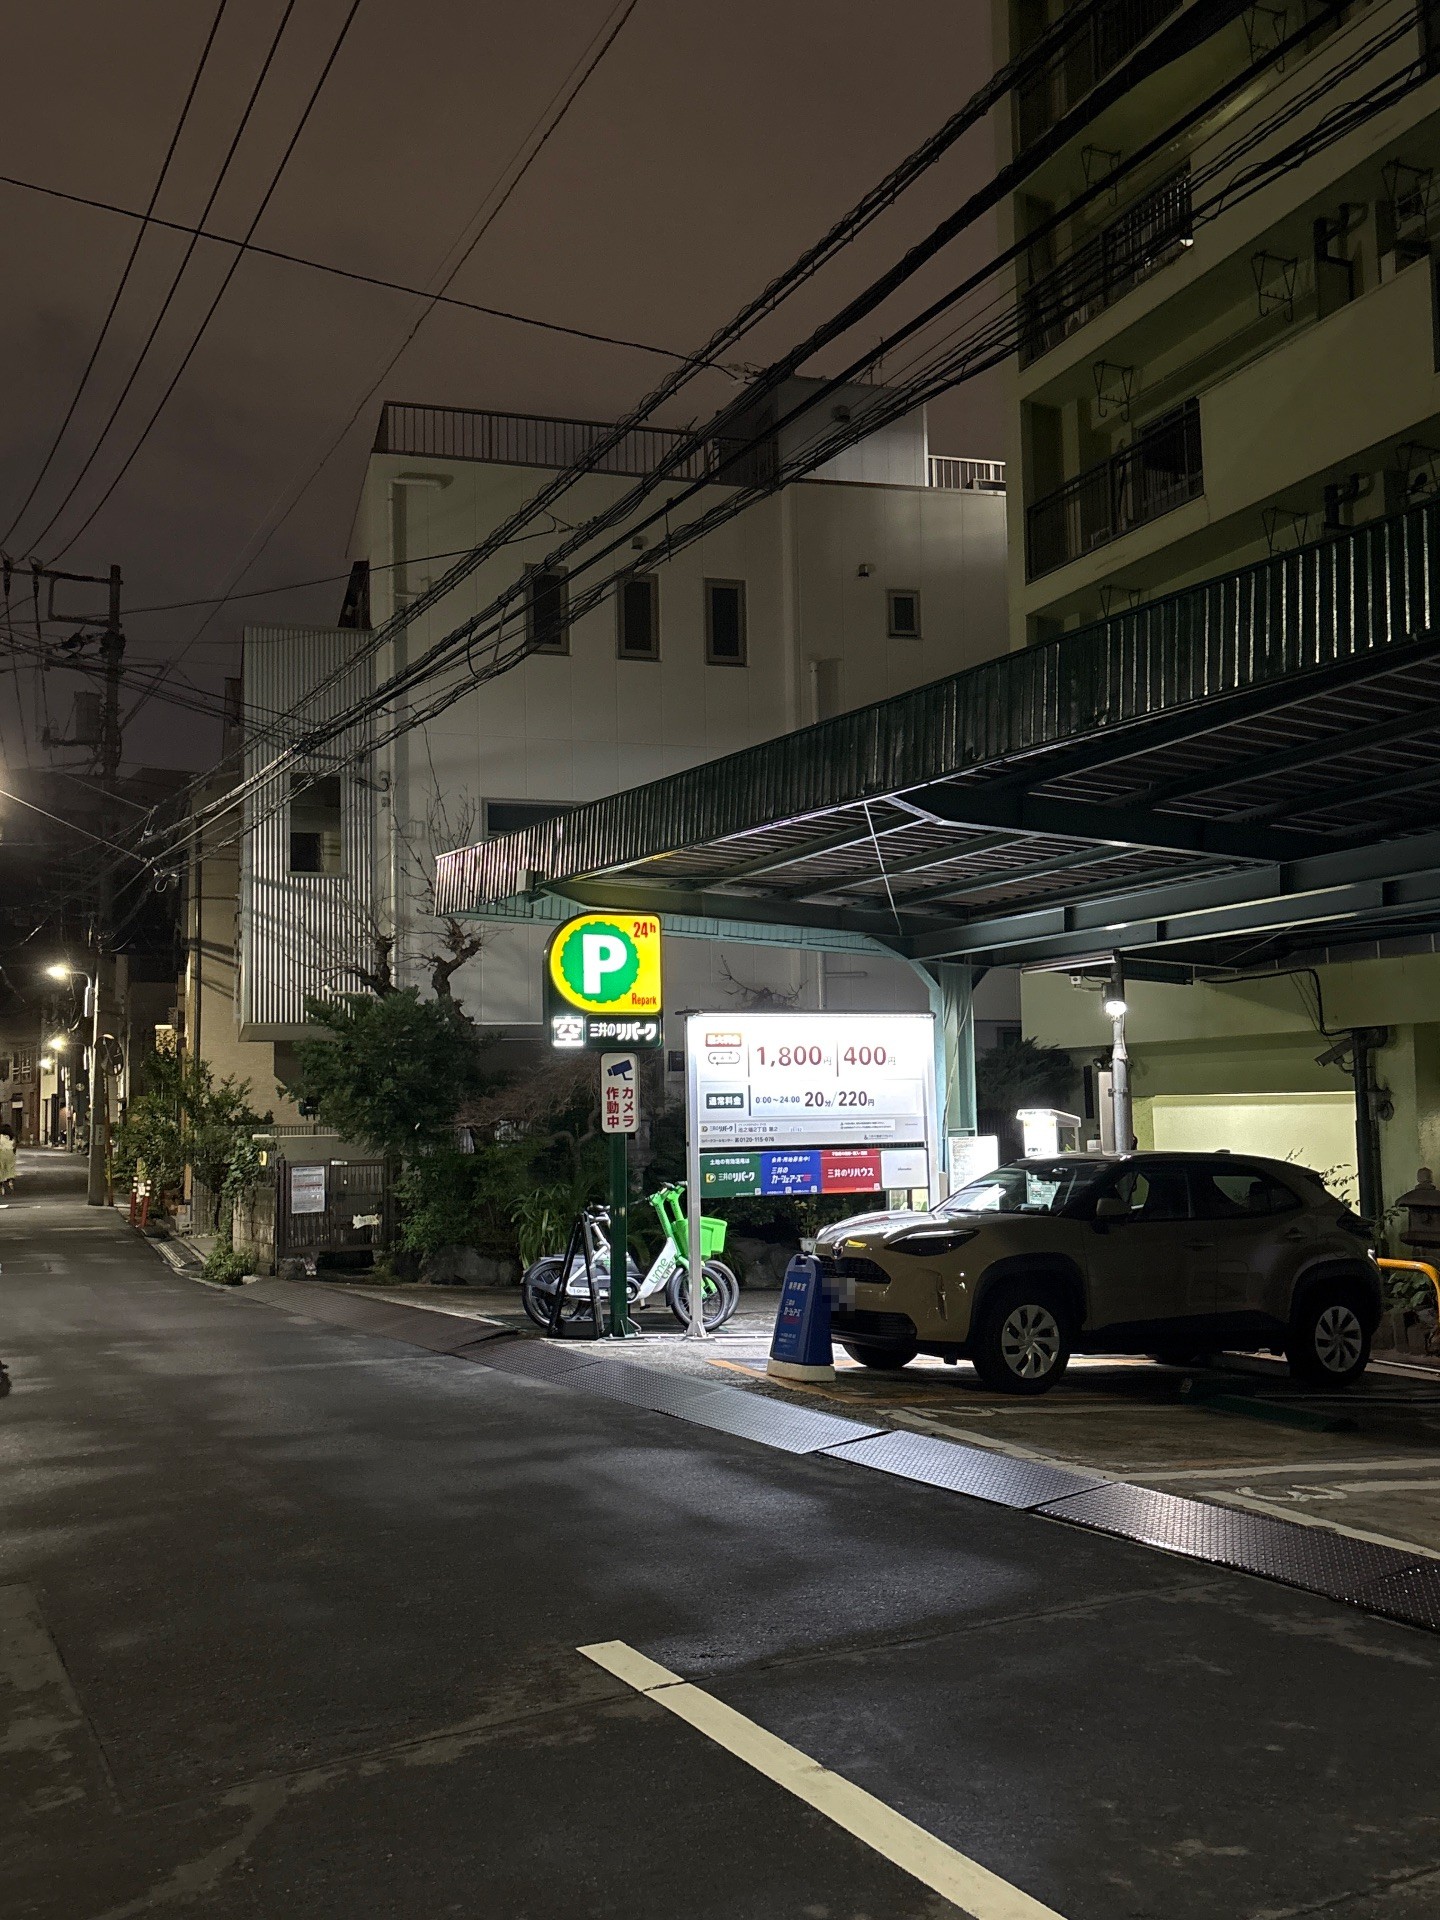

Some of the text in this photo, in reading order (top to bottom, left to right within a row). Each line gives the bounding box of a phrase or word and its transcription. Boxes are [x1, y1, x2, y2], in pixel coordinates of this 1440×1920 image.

[634, 921, 656, 939] 24h
[582, 933, 628, 994] P
[631, 993, 657, 1006] Repark
[553, 1017, 583, 1045] 空
[590, 1022, 657, 1041] 三井のリパーク
[606, 1087, 620, 1129] 作動中
[622, 1087, 634, 1127] カメラ
[708, 1096, 742, 1106] 通常料金
[718, 1171, 755, 1182] 三井のリパーク
[771, 1166, 788, 1174] 三井の
[827, 1167, 875, 1178] 三井のリハウス
[649, 1258, 669, 1284] Lime
